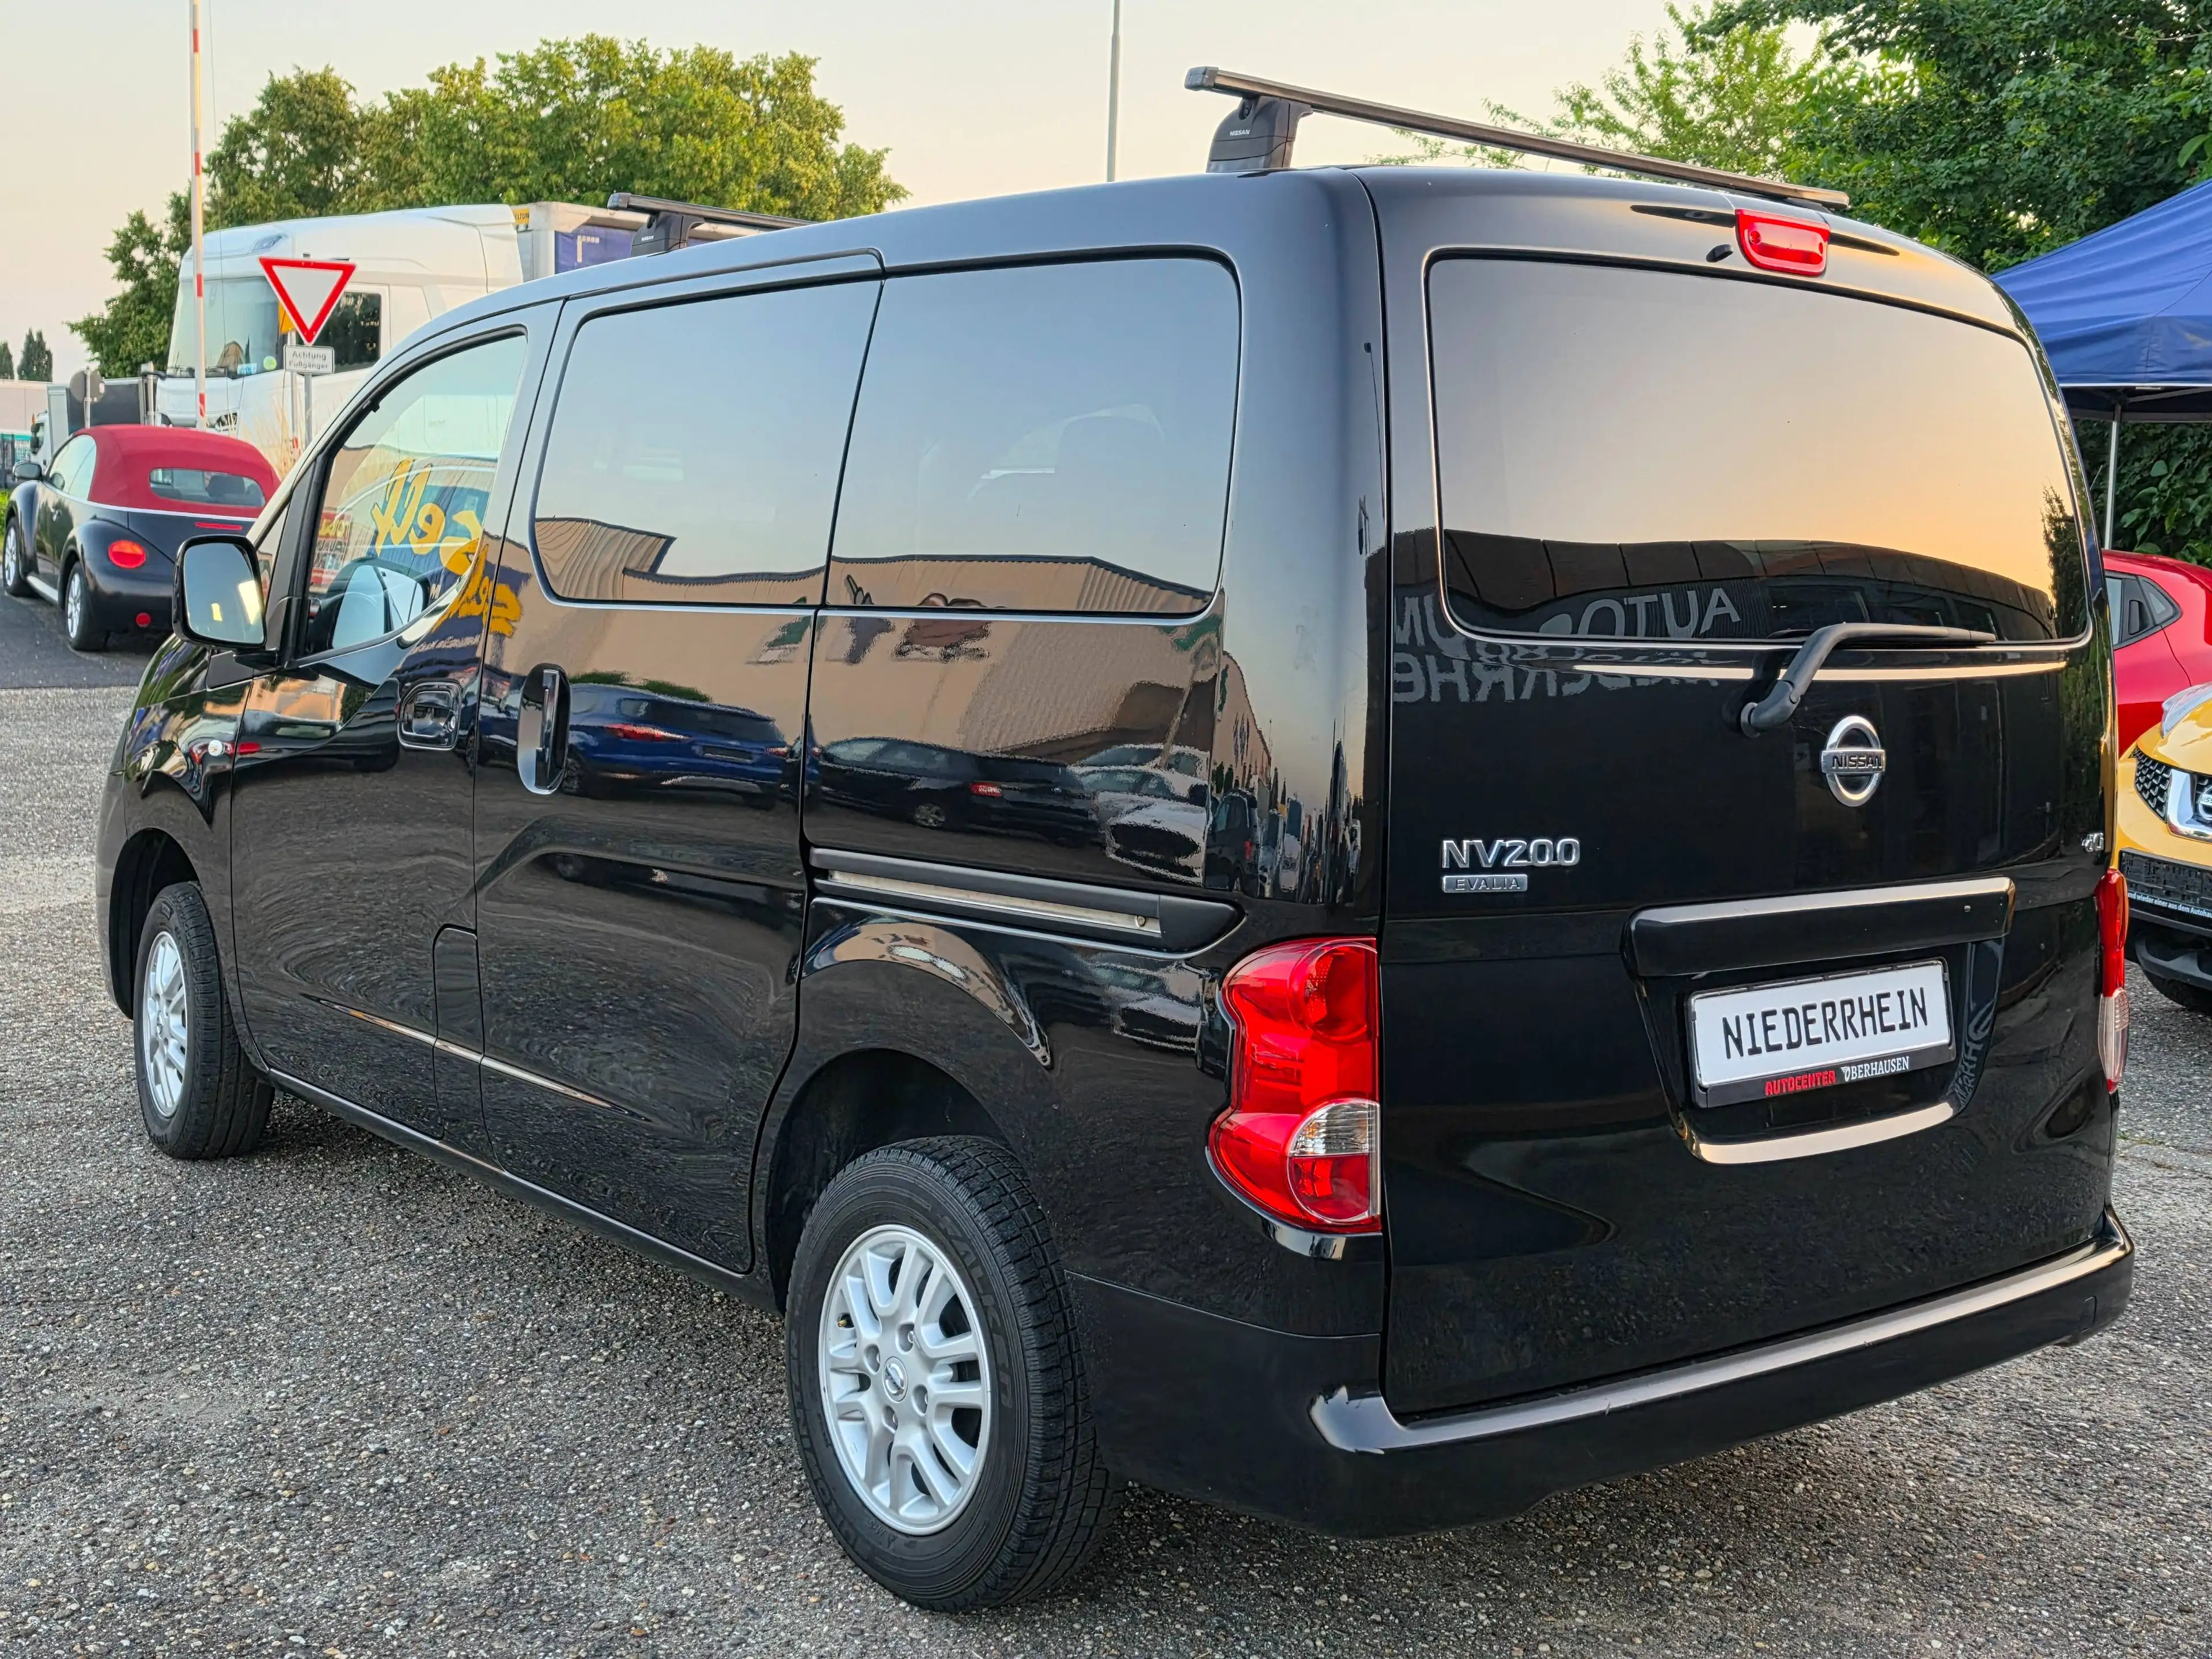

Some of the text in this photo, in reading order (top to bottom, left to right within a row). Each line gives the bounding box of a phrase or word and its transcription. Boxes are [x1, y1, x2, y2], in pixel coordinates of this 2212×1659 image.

[293, 350, 327, 361] Achtung
[1832, 754, 1883, 769] NISSAN
[1442, 838, 1581, 868] NV200
[1455, 877, 1521, 891] EVALIA
[2137, 894, 2154, 904] wieder
[2154, 899, 2168, 907] einer
[2178, 904, 2190, 912] dem
[1722, 987, 1928, 1059] NIEDERRHEIN
[1764, 1056, 1910, 1096] AUTOCENTER OBERHAUSEN
